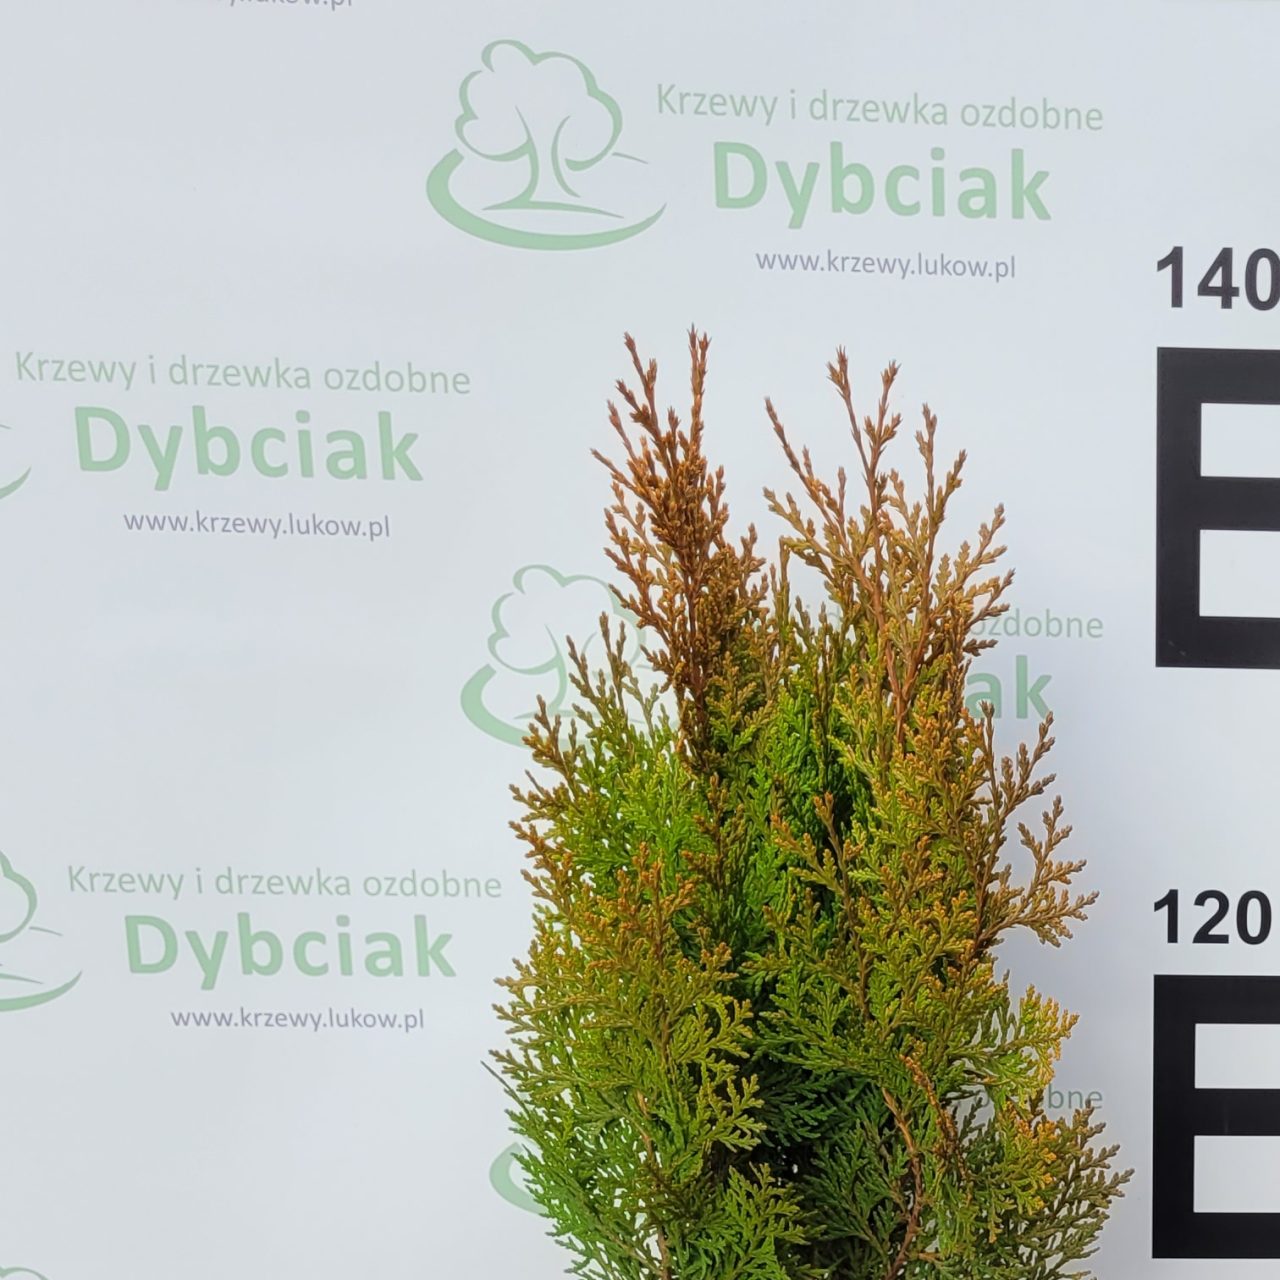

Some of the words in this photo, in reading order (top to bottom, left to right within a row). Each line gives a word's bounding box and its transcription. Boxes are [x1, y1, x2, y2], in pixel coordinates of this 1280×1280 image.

[657, 83, 778, 127] Krzewy
[789, 90, 797, 119] i
[809, 90, 948, 126] drzewka
[960, 98, 1103, 131] ozdobne
[713, 141, 1052, 230] Dybciak
[756, 249, 1016, 283] www.krzewy.lukow.pl
[15, 351, 137, 390] Krzewy
[149, 355, 157, 384] i
[168, 355, 311, 389] drzewka
[324, 361, 471, 394] ozdobne
[75, 405, 423, 491] Dybciak
[123, 510, 390, 541] www.krzewy.lukow.pl
[67, 865, 185, 900] Krzewy
[196, 867, 204, 894] i
[215, 868, 352, 896] drzewka
[363, 869, 502, 898] ozdobne
[1153, 889, 1273, 945] 120
[124, 912, 457, 991] Dybciak
[170, 1007, 425, 1033] www.krzewy.lukow.pl
